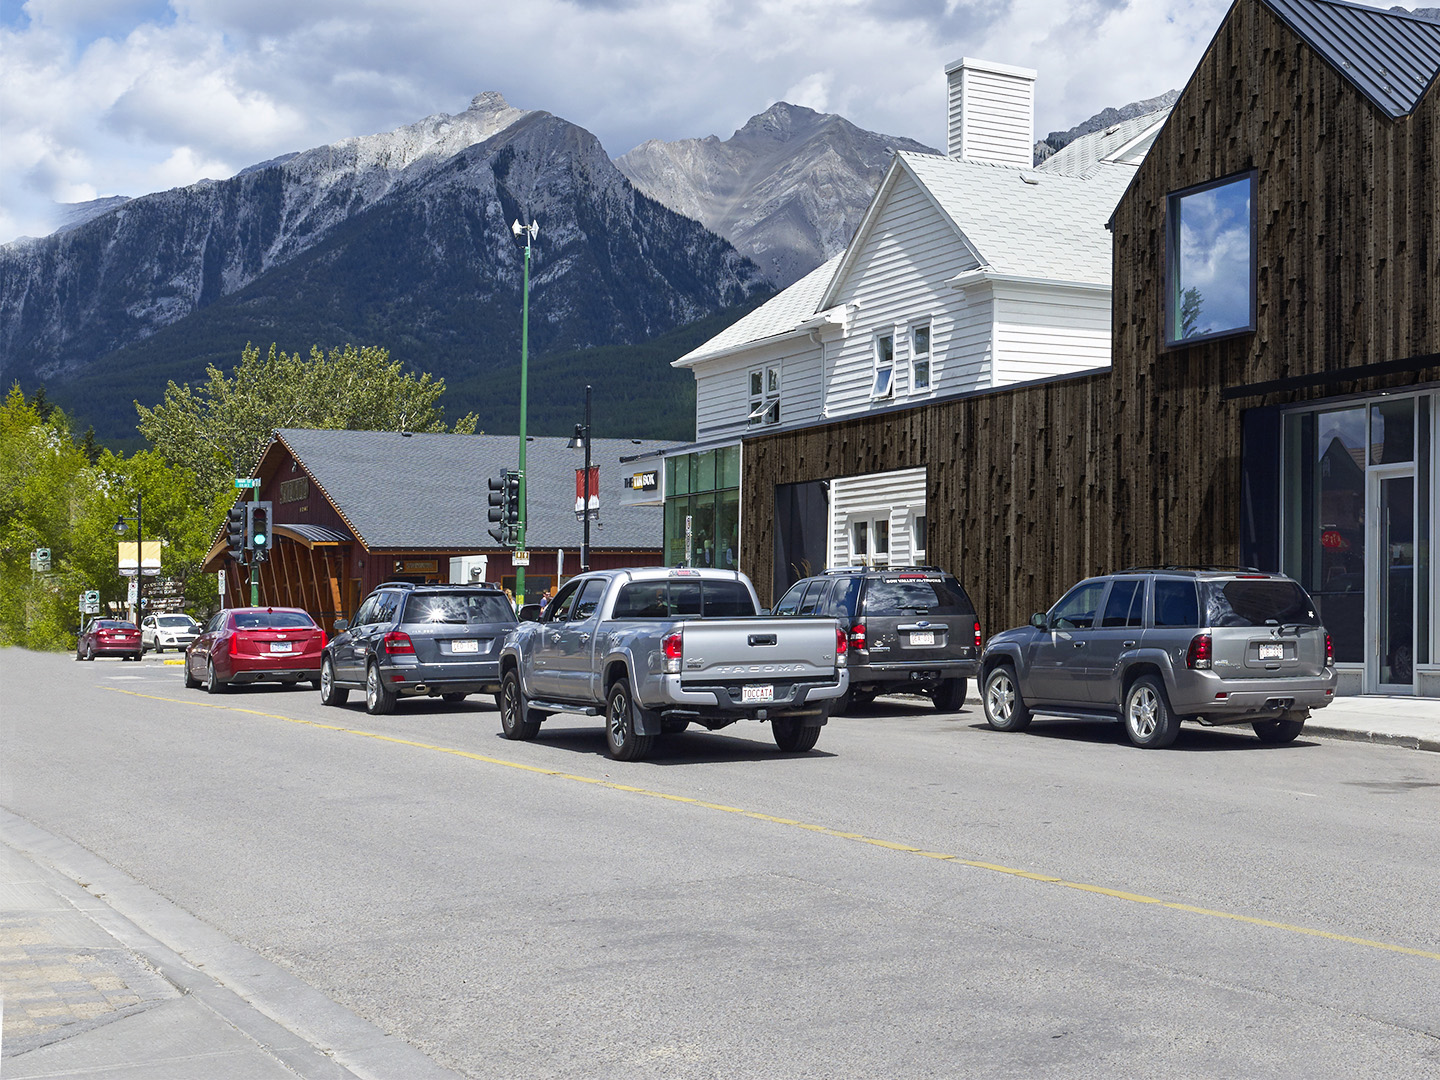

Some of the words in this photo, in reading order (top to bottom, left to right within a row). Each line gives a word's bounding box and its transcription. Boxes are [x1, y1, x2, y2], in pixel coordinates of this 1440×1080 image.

[624, 477, 634, 489] THE
[633, 475, 643, 487] TIN
[643, 474, 655, 486] BOX
[717, 665, 806, 674] TACOMA
[743, 689, 774, 698] TOCCATA
